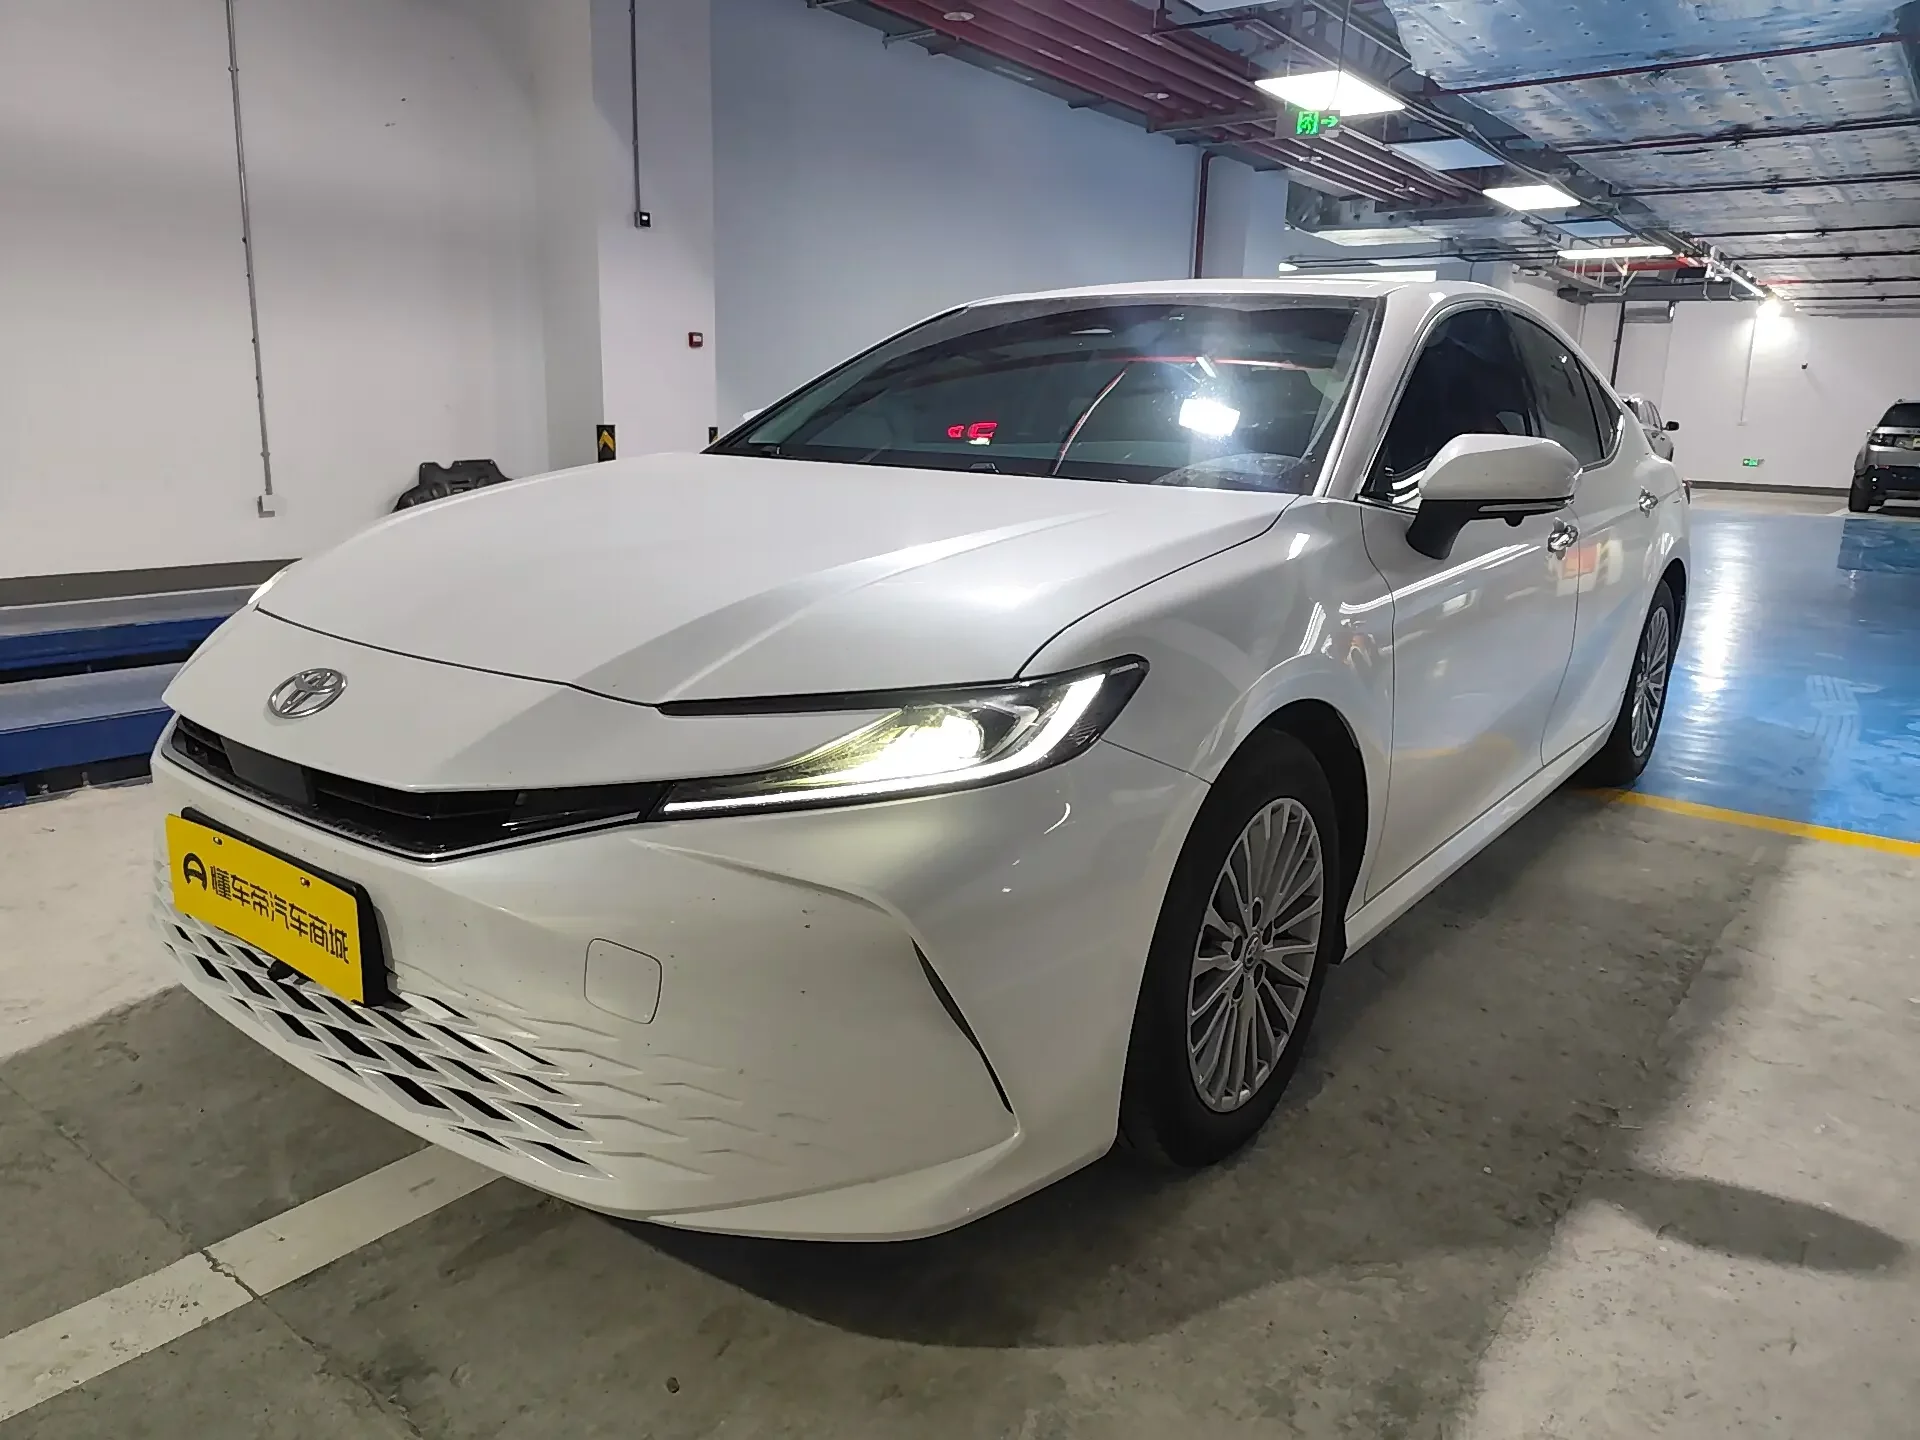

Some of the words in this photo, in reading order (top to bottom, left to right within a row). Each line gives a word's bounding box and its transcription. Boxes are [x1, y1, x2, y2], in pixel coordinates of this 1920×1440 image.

[210, 865, 349, 964] 懂车帝汽车商城
